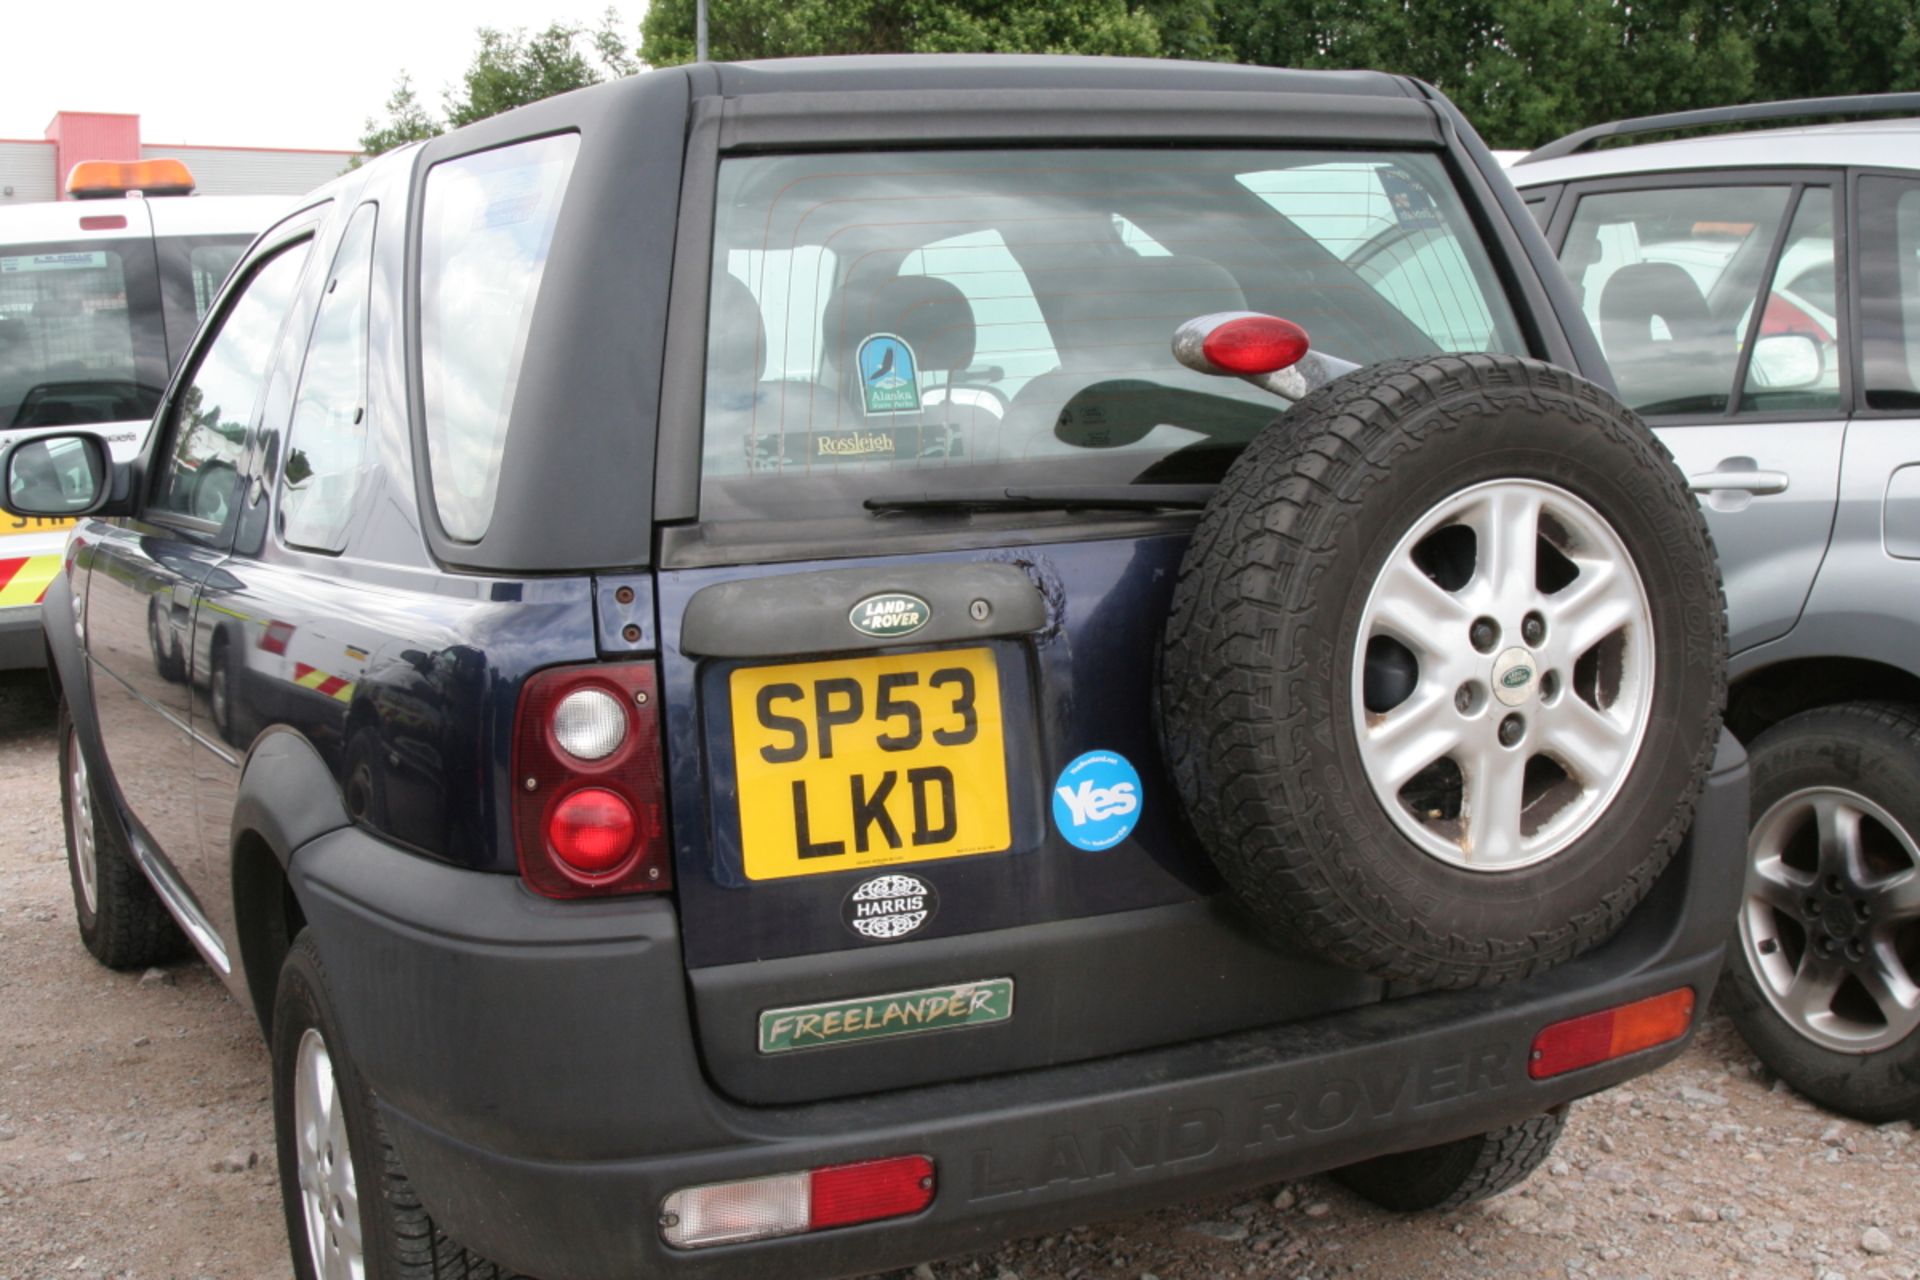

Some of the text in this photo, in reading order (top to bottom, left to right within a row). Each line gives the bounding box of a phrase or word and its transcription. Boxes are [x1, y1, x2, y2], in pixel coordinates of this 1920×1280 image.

[871, 390, 913, 401] Alaska
[818, 431, 894, 455] Rossleigh
[865, 600, 906, 616] LAND
[871, 612, 919, 629] ROVER
[756, 667, 978, 764] SP53
[792, 766, 957, 860] LKD
[1056, 779, 1137, 827] Yes
[857, 895, 924, 918] HARRIS
[769, 990, 996, 1043] FREELANDER
[968, 1042, 1510, 1202] LAND ROVER
